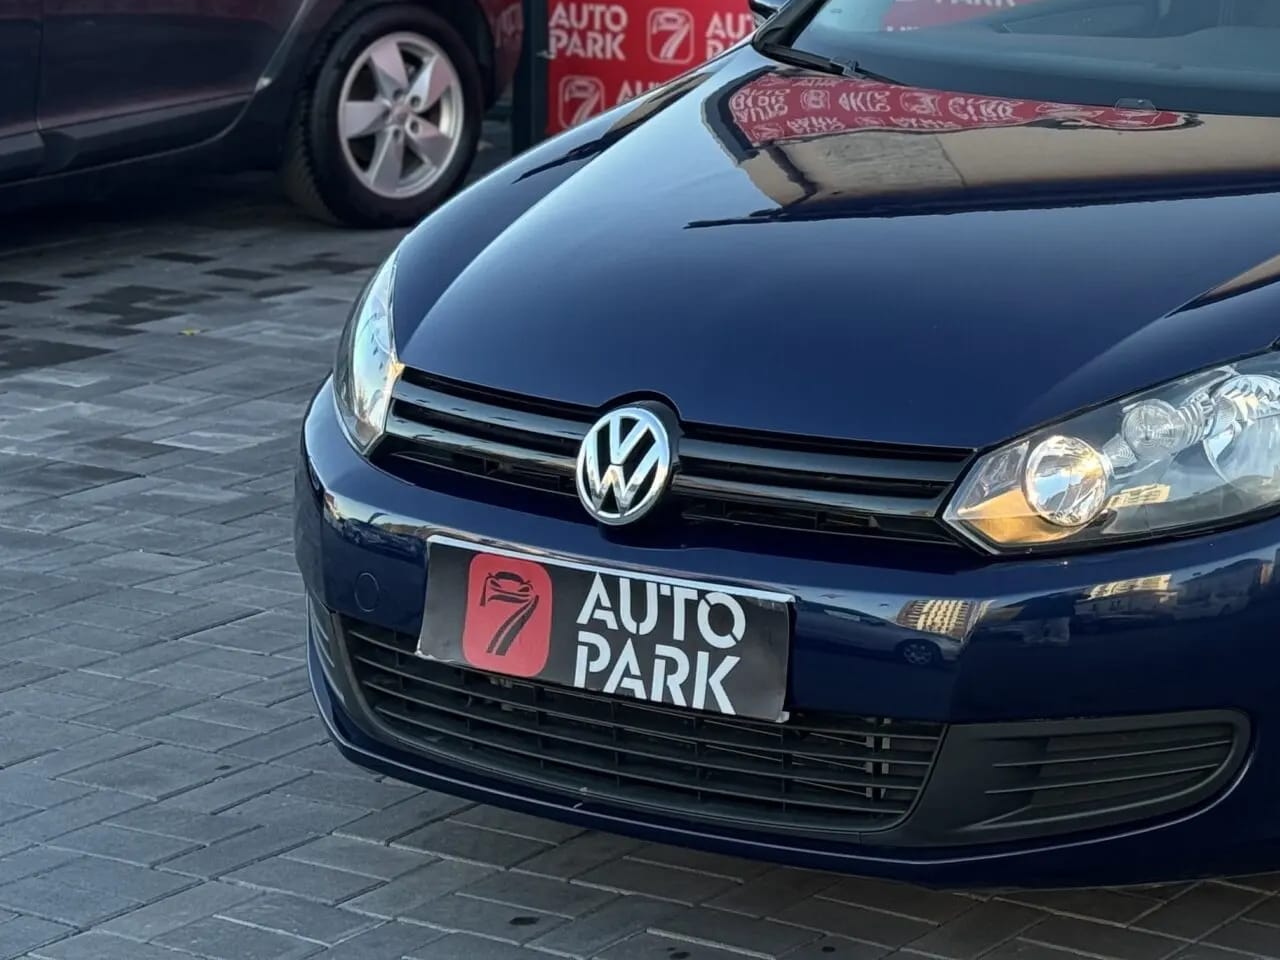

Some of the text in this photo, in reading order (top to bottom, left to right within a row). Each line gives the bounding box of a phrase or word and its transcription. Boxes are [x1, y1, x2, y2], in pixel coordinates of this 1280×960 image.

[549, 2, 628, 33] AUTO
[549, 29, 625, 60] PARK
[576, 571, 746, 647] AUTO
[573, 635, 740, 716] PARK
